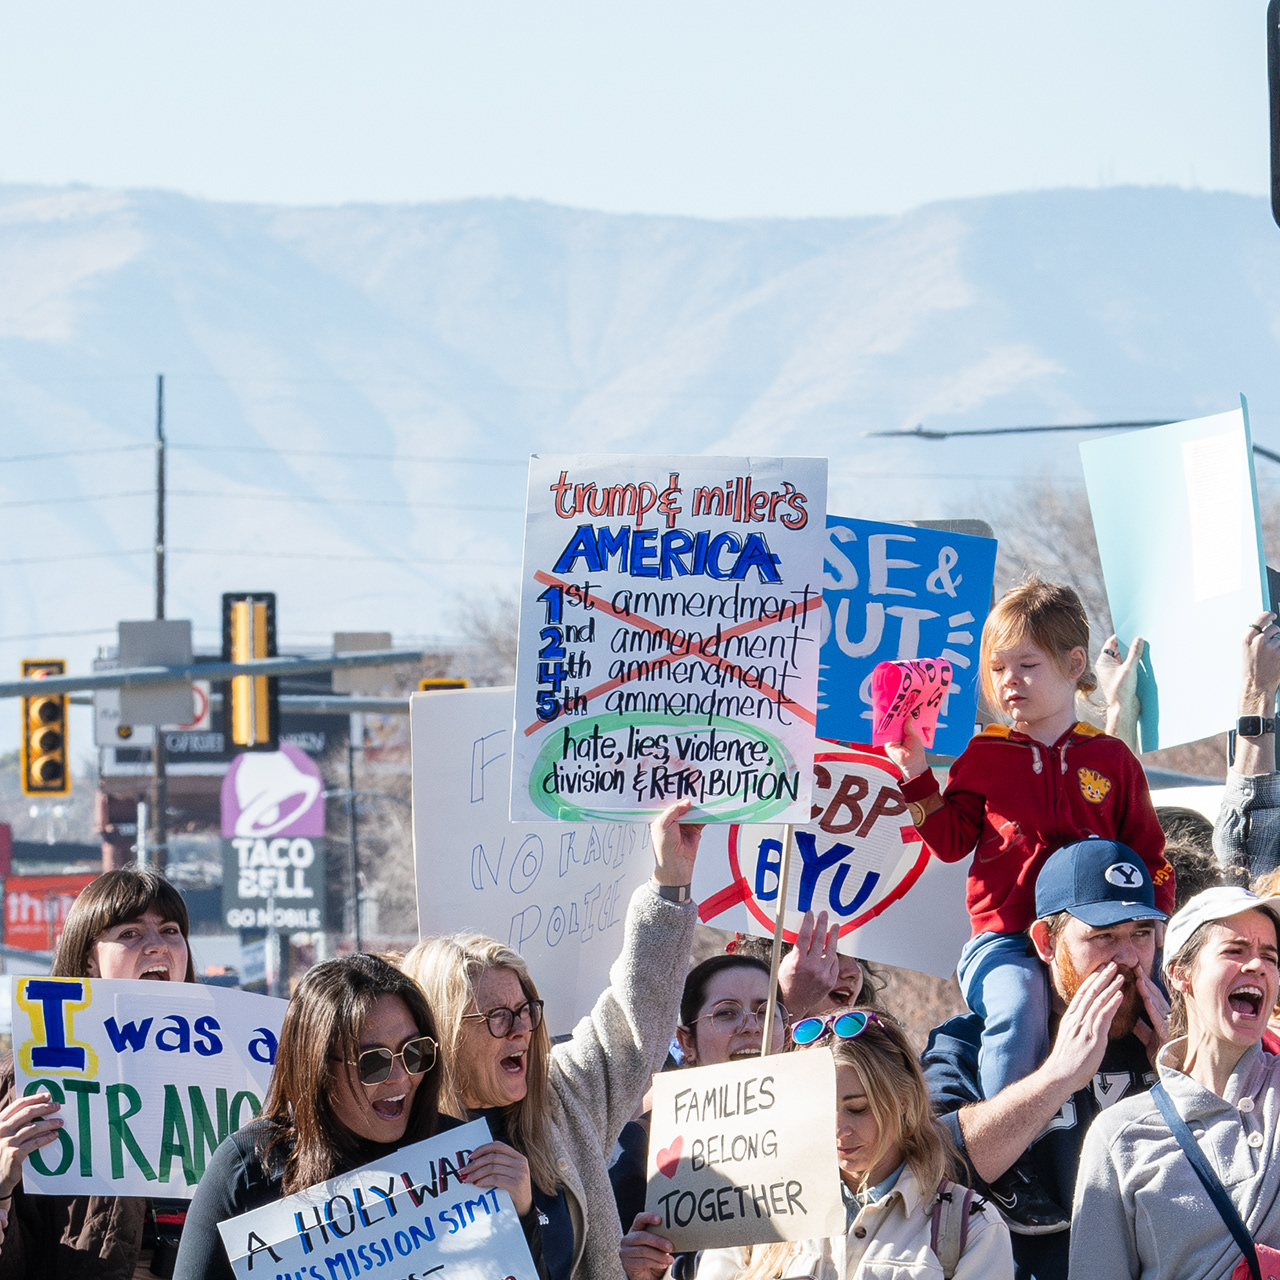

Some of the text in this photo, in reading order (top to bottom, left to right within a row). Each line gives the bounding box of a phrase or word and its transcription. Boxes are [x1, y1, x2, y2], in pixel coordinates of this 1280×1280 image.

[551, 471, 657, 527] trump
[552, 524, 783, 584] AMERICA
[542, 764, 625, 795] division
[232, 838, 315, 868] TACO
[754, 831, 881, 916] BYU
[238, 868, 314, 899] BELL
[25, 979, 86, 1071] I
[103, 1014, 224, 1056] was
[674, 1075, 776, 1125] FAMILIES
[691, 1129, 778, 1172] BELONG
[247, 1231, 283, 1271] A
[294, 1176, 399, 1254] HOLY
[657, 1180, 808, 1229] TOGETHER
